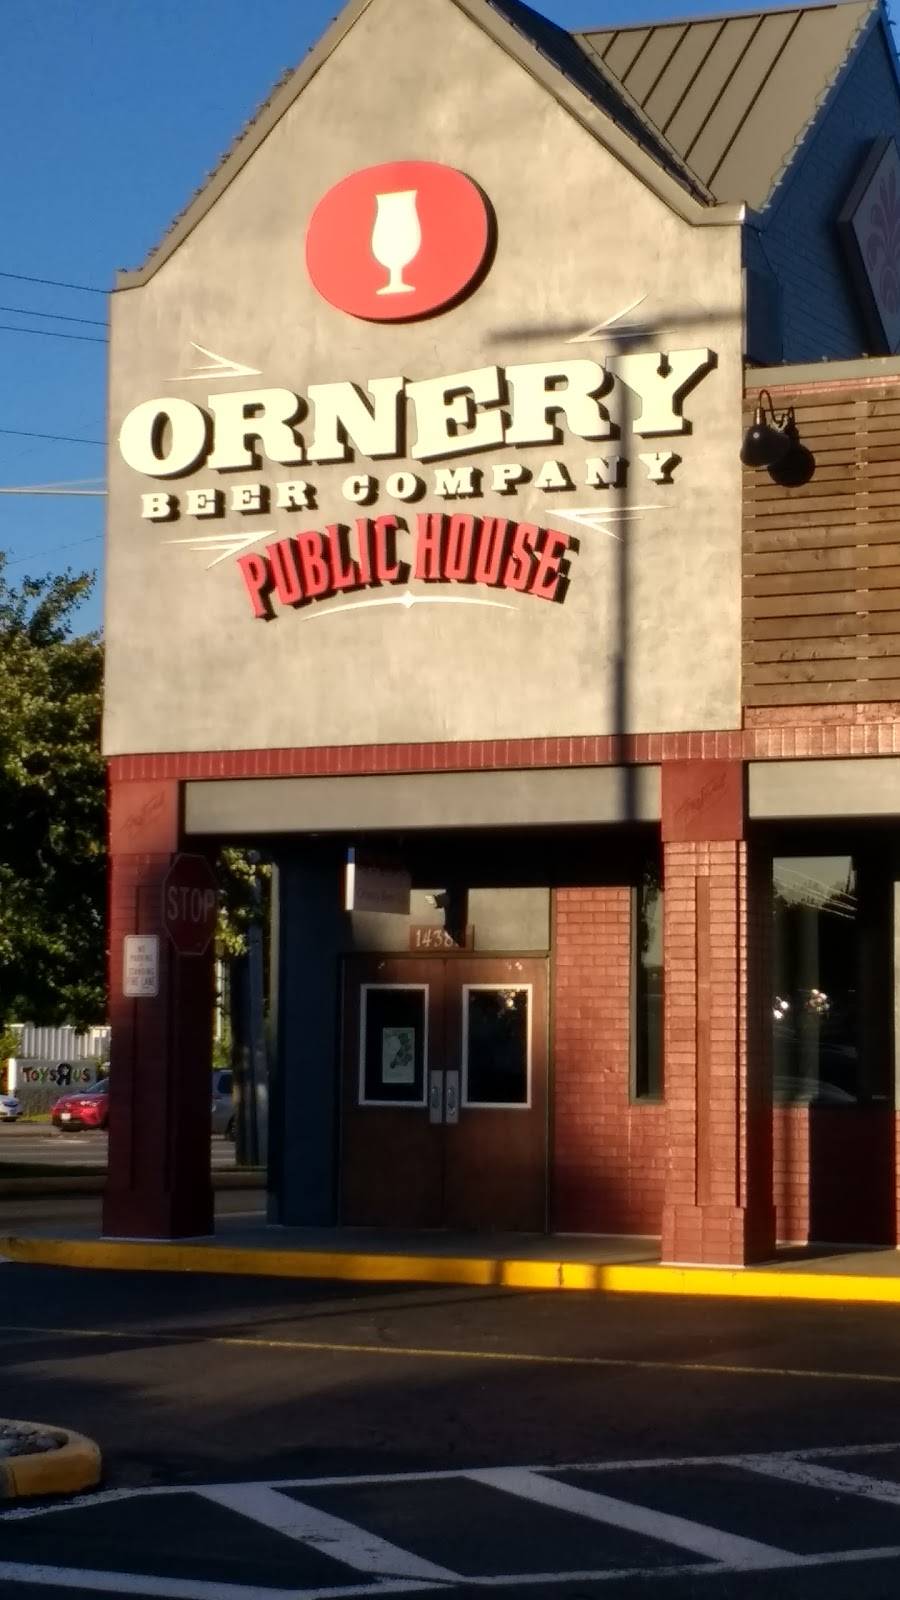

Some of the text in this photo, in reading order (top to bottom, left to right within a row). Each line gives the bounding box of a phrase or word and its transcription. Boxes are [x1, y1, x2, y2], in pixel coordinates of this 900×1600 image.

[118, 347, 717, 478] ORNERY
[140, 450, 684, 522] BEER COMPANY
[236, 512, 580, 620] PUBLIC HOUSE
[167, 886, 215, 923] STOP
